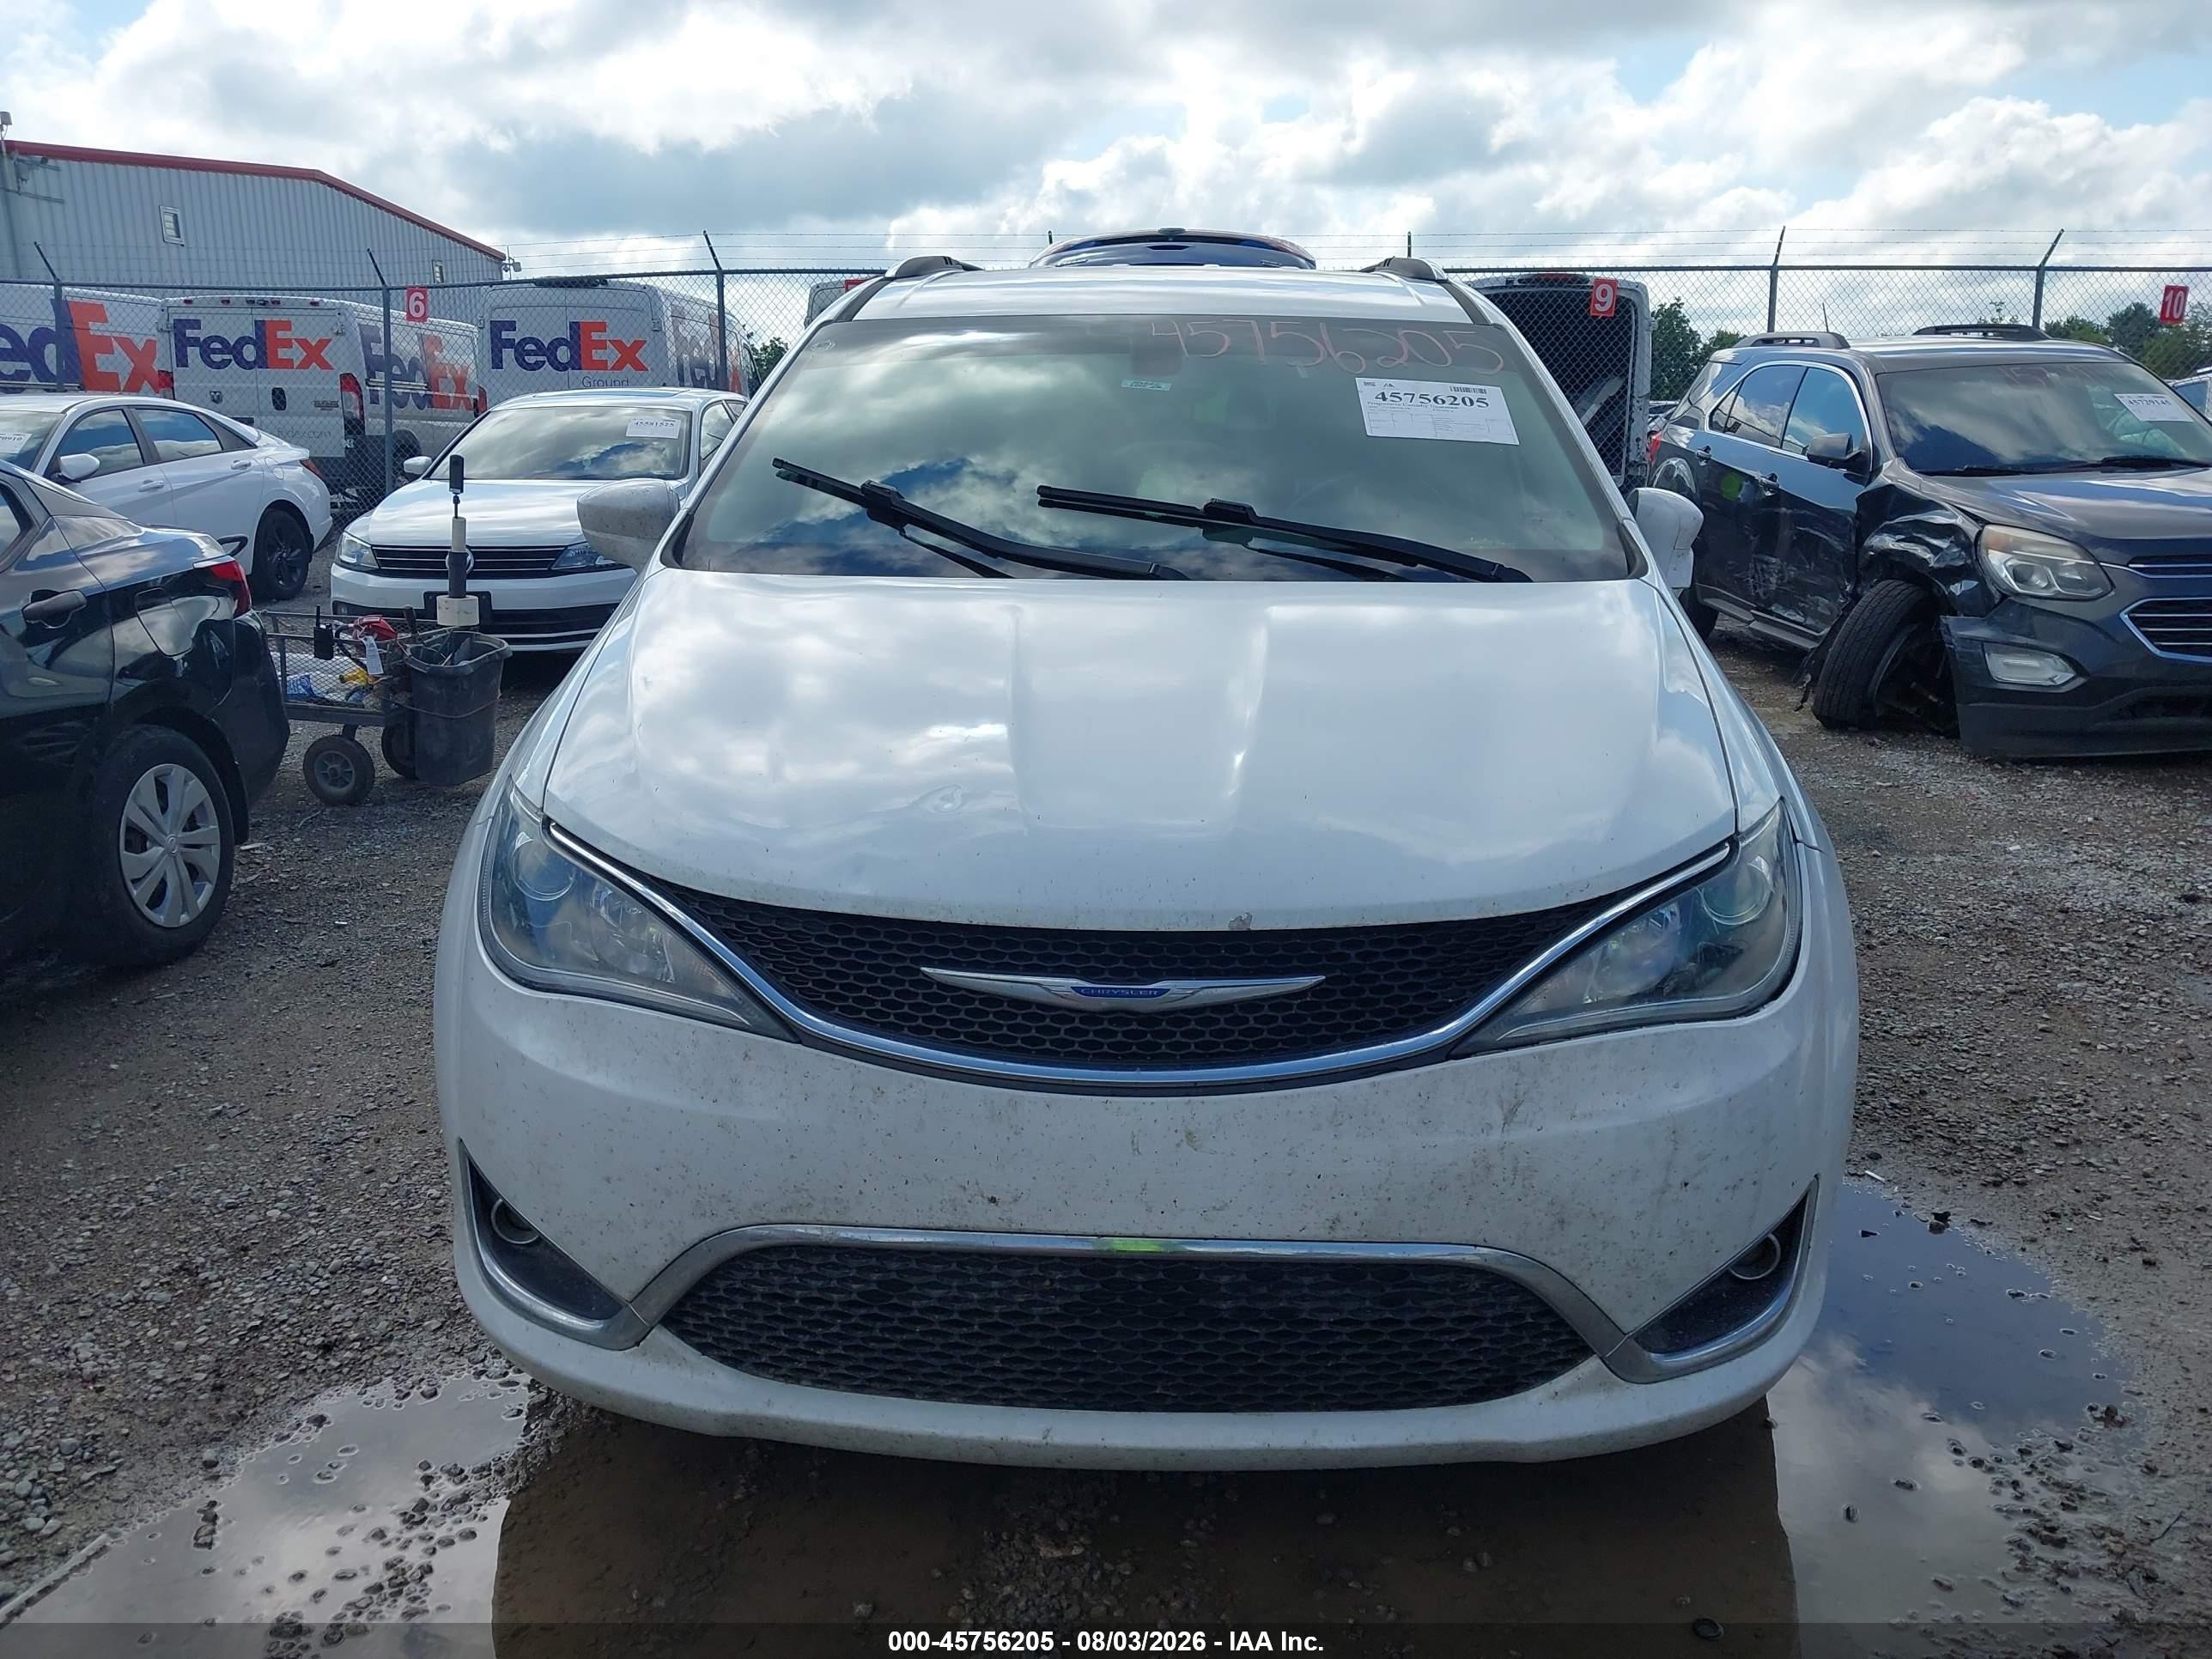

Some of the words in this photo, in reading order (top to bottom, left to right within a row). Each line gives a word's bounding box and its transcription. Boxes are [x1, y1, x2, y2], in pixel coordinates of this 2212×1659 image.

[410, 292, 425, 318] 6
[1595, 283, 1613, 312] 9
[2165, 289, 2185, 319] 10
[0, 299, 161, 394] edEx
[173, 319, 334, 370] FedEx
[490, 320, 649, 372] FedEx
[1152, 319, 1504, 375] 45756205
[357, 323, 474, 410] FedEx
[582, 375, 629, 387] Ground
[1374, 391, 1490, 409] 45756205
